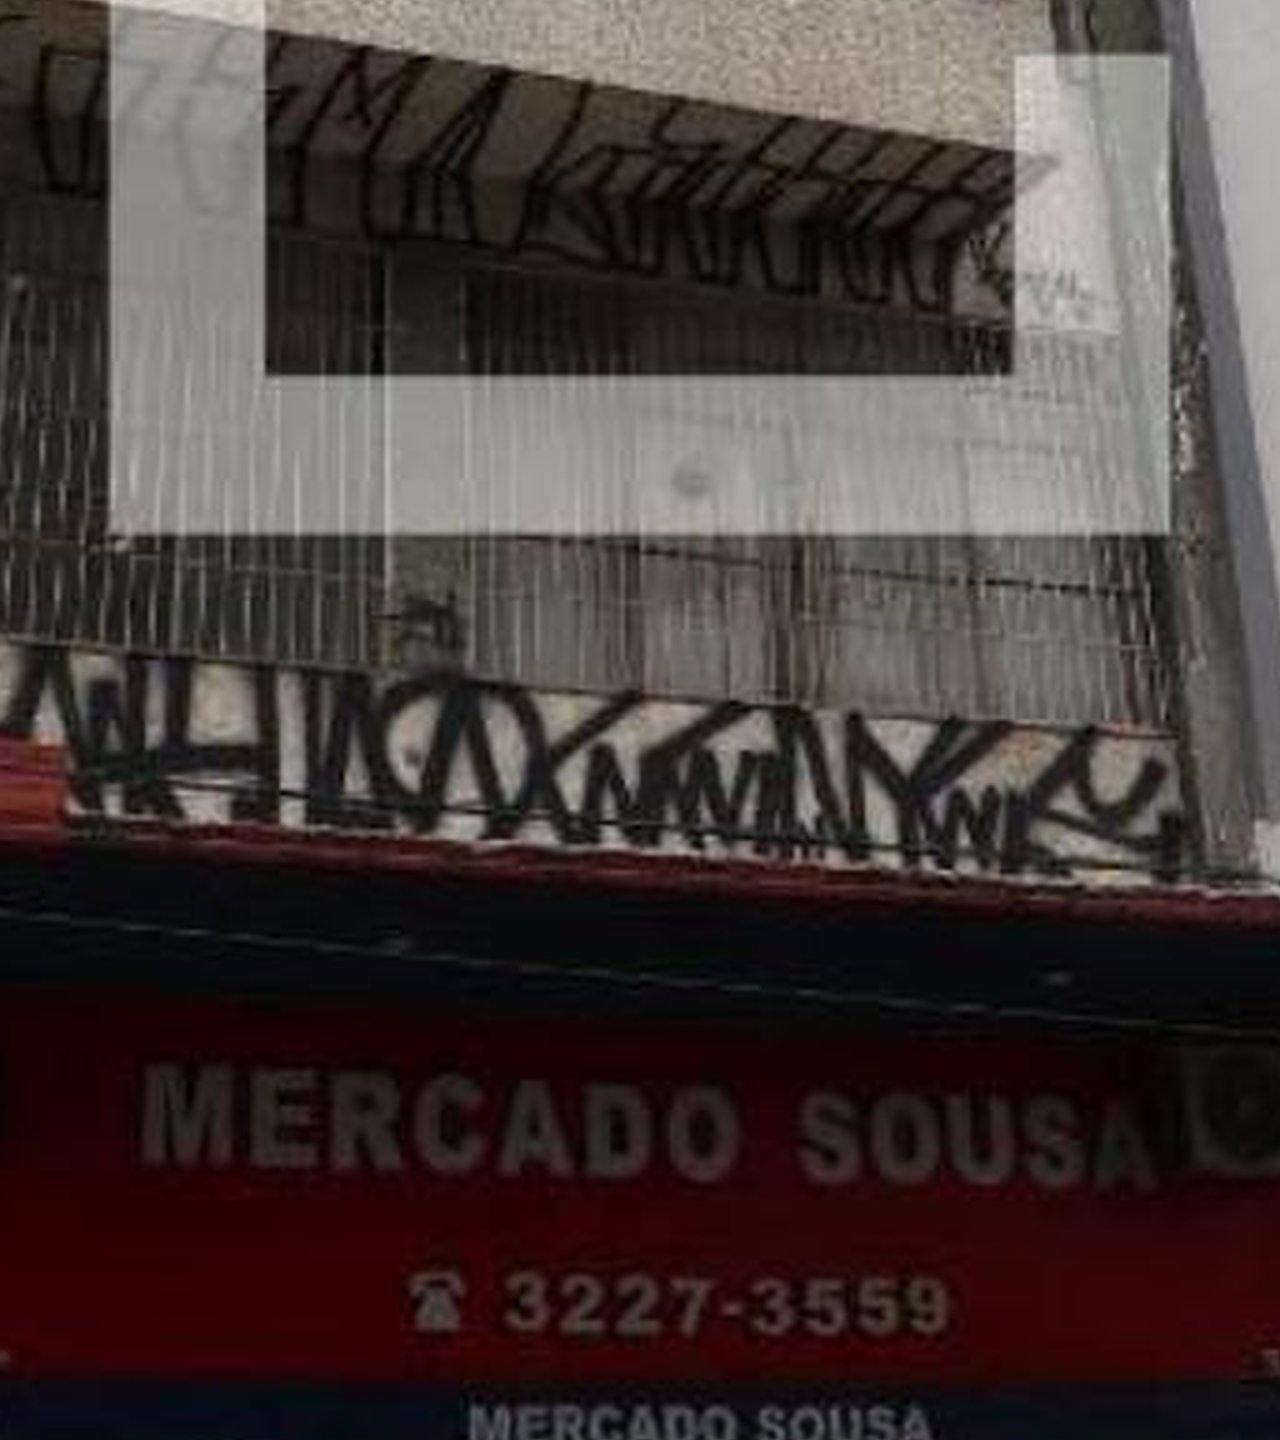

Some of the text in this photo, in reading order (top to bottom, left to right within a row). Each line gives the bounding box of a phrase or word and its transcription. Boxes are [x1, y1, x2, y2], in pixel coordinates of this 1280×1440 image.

[140, 1062, 1161, 1191] MERCADO SOUSA
[501, 1272, 952, 1339] 3227-3559
